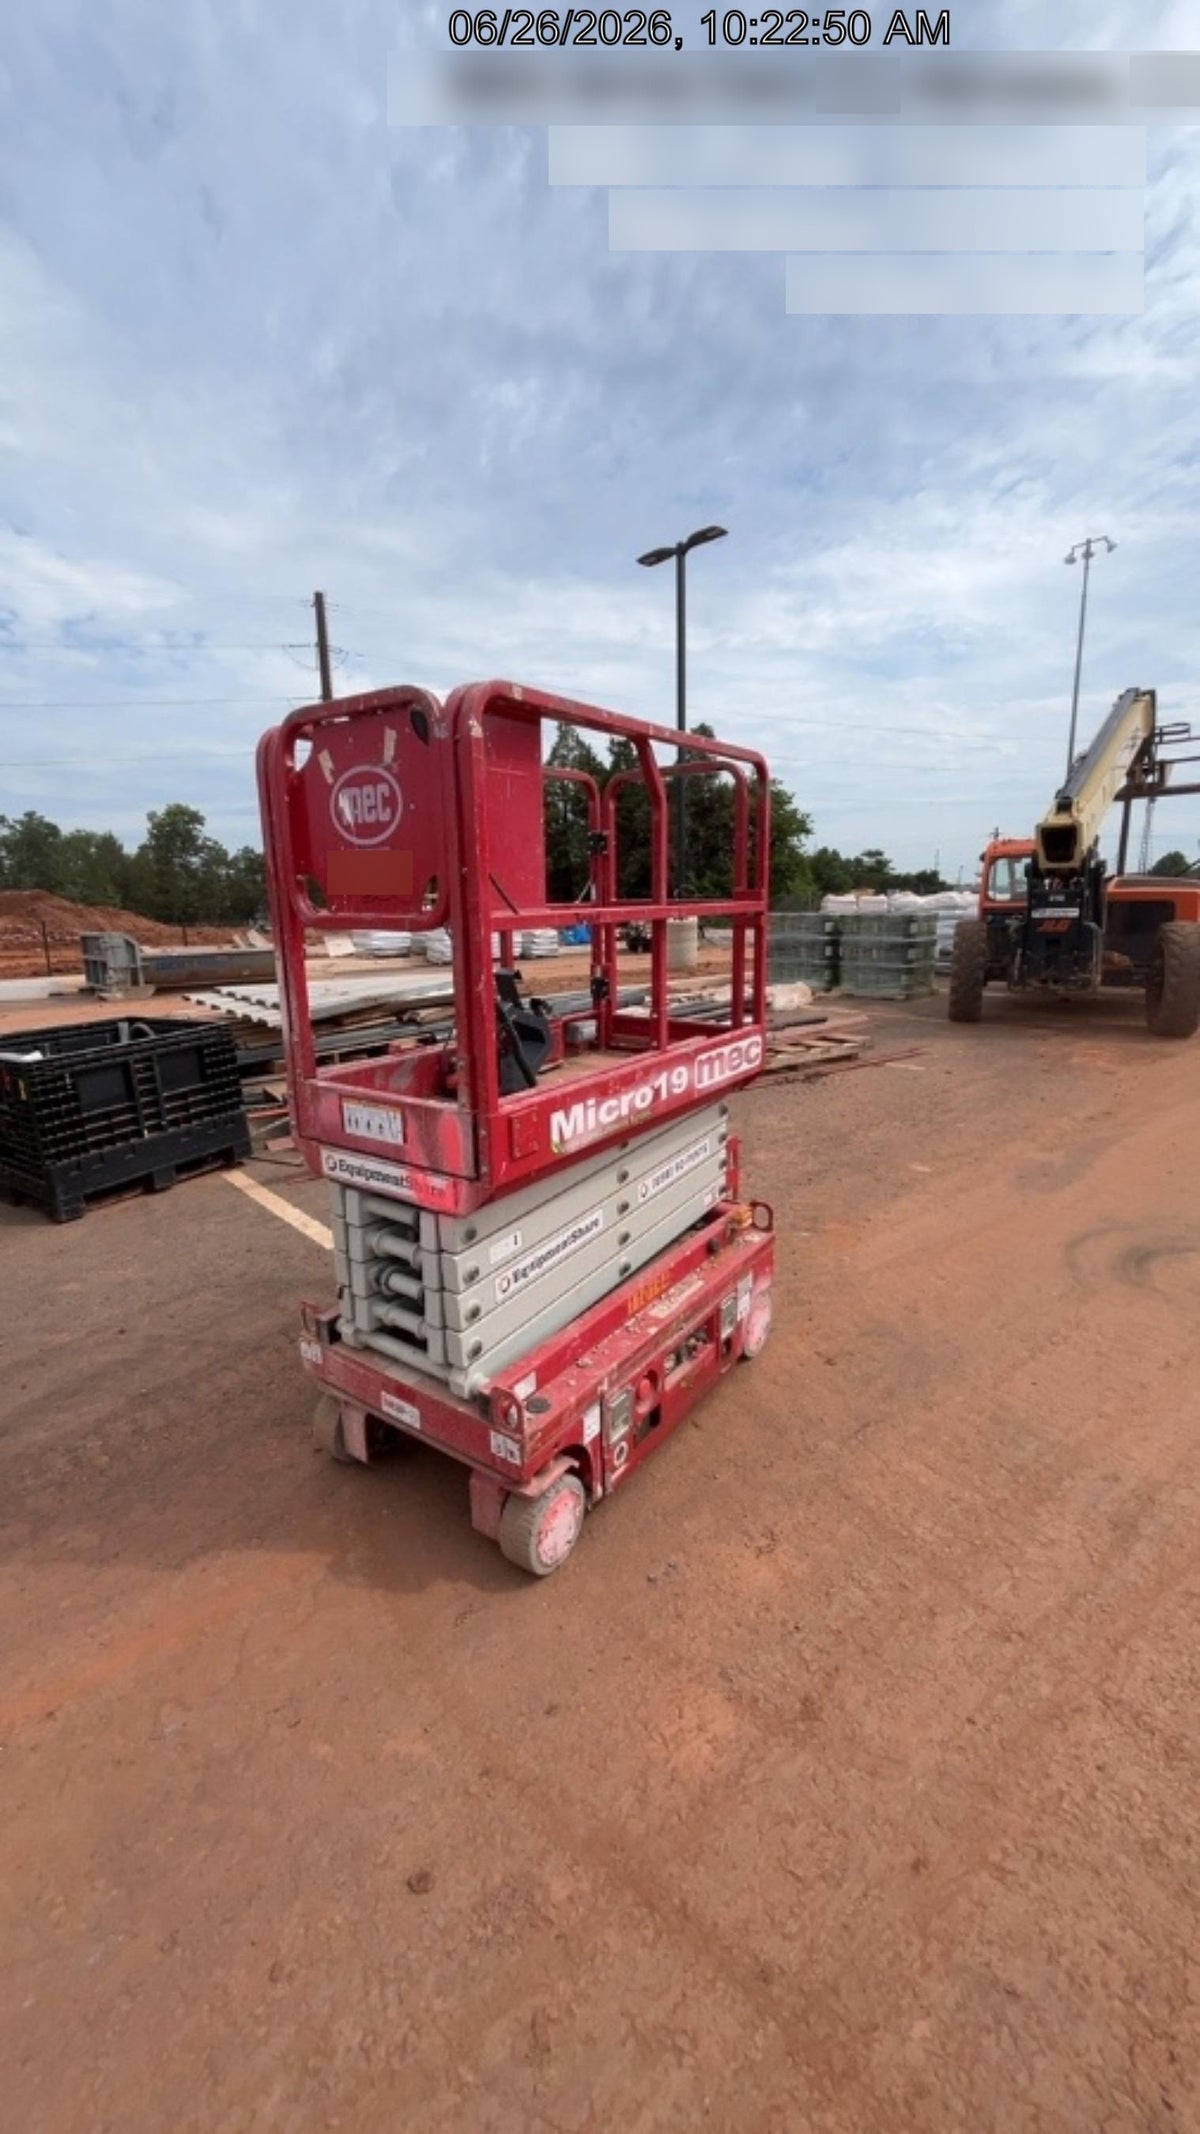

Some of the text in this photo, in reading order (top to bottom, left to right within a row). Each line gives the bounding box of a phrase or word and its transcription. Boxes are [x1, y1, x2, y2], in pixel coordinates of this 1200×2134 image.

[551, 1039, 762, 1144] Micro19 mec
[338, 1158, 446, 1197] EquipmentSre
